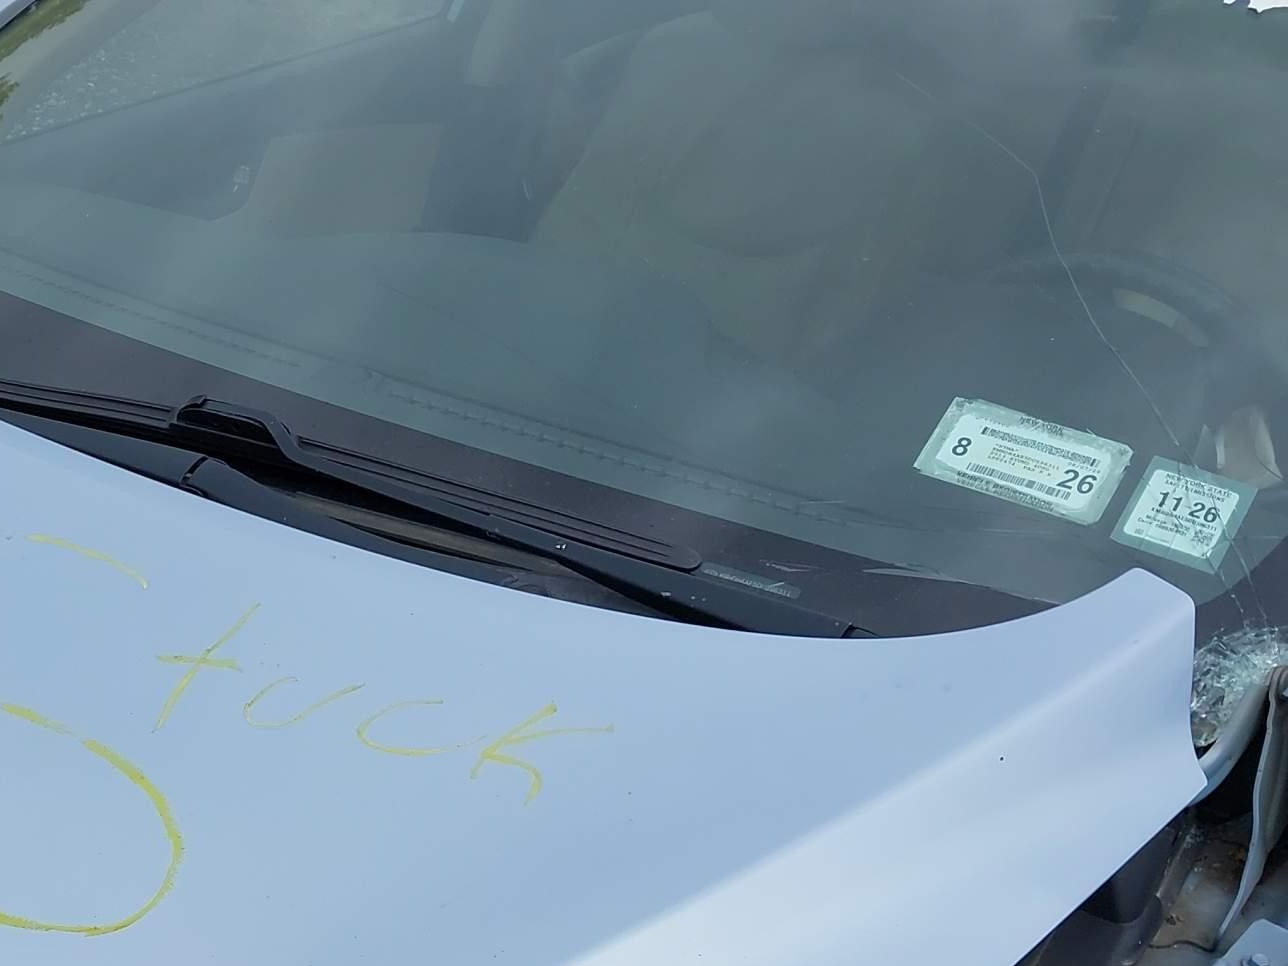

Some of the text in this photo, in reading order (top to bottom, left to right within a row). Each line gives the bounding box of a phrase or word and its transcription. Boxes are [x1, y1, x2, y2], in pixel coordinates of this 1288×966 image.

[951, 437, 972, 457] 8
[1056, 468, 1098, 494] 26
[1188, 502, 1218, 523] 26
